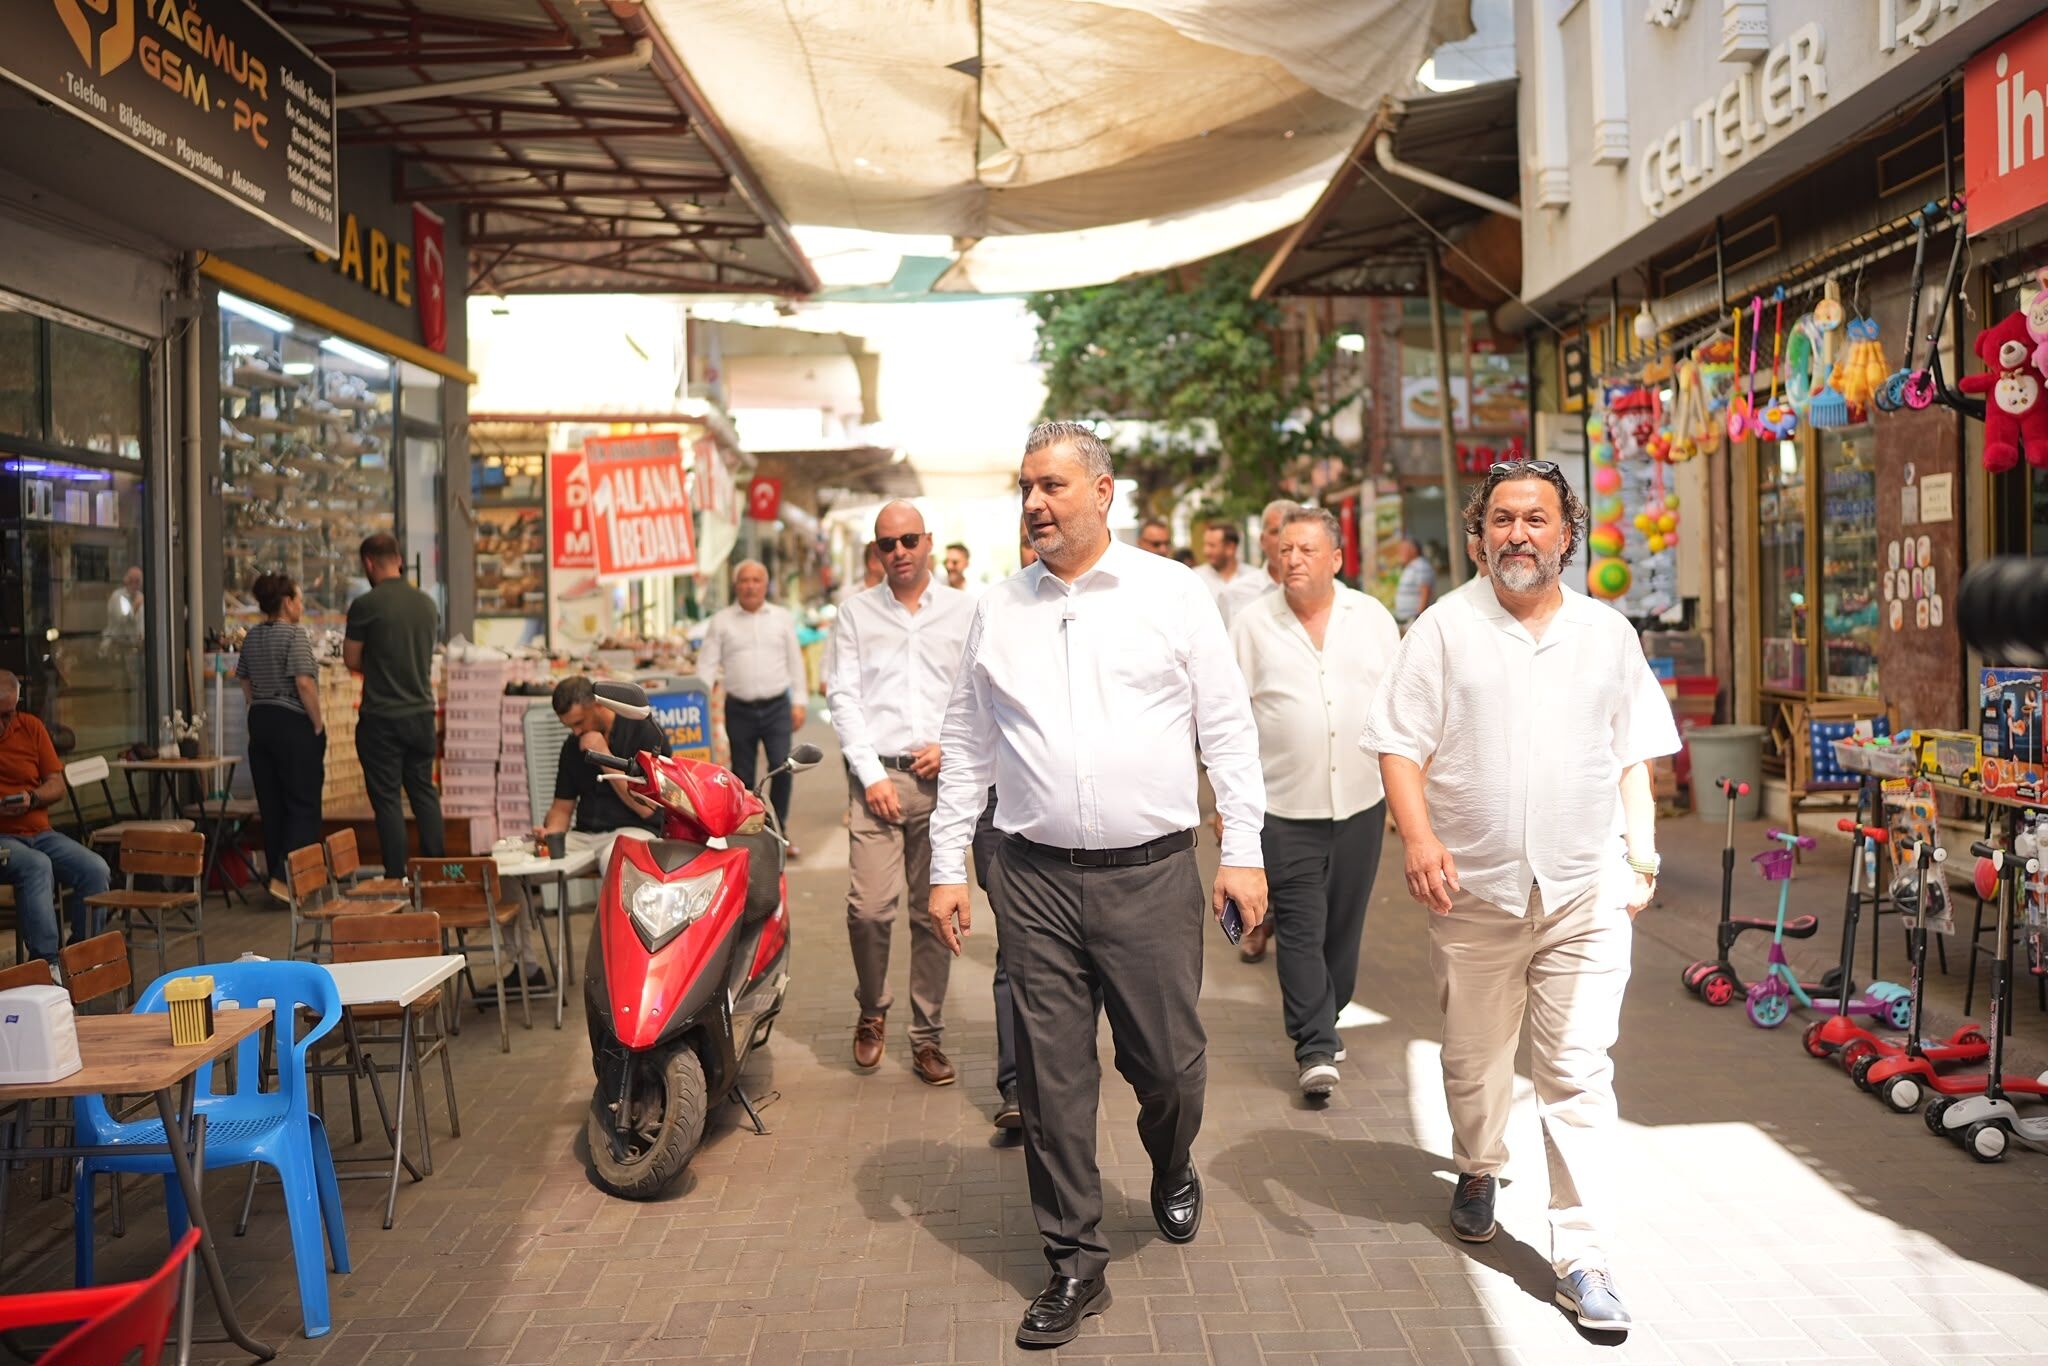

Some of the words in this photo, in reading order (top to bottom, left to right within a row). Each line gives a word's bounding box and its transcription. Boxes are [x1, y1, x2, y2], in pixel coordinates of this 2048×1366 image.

[66, 72, 107, 113] Telefon
[118, 102, 168, 147] Bilgisayar
[176, 136, 224, 180] Playstation
[139, 35, 210, 112] GSM
[233, 97, 269, 149] PC
[280, 65, 307, 103] Teknik
[308, 86, 331, 119] Servis
[1640, 20, 1828, 219] ÇELTELER
[1996, 52, 2048, 177] ih
[615, 463, 685, 512] ALANA
[618, 512, 692, 567] BEDAVA
